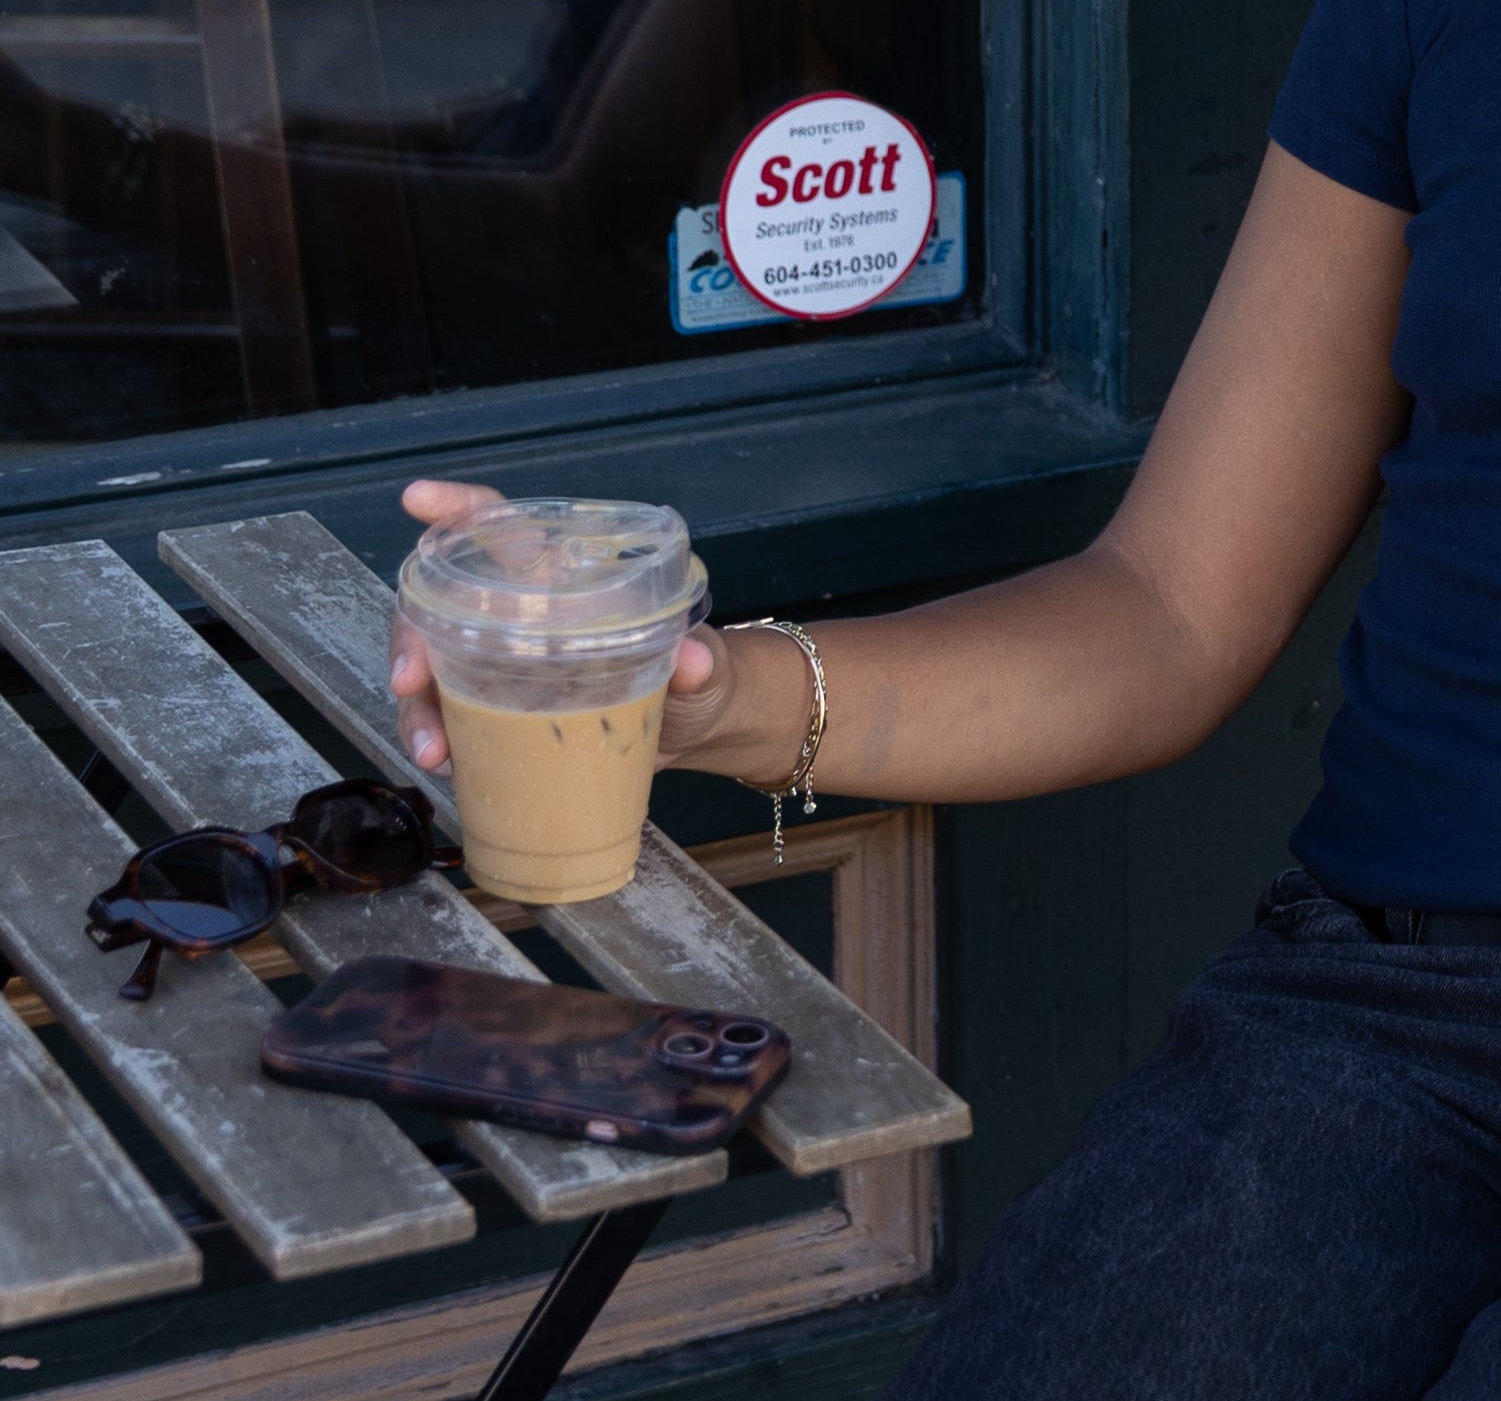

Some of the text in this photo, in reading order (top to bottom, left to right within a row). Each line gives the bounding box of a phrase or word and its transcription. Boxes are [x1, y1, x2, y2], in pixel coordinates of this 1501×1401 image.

[789, 119, 866, 138] PROTECTED
[755, 143, 902, 208] Scott
[756, 208, 899, 239] Security Systems
[763, 250, 898, 285] 604-451-0300
